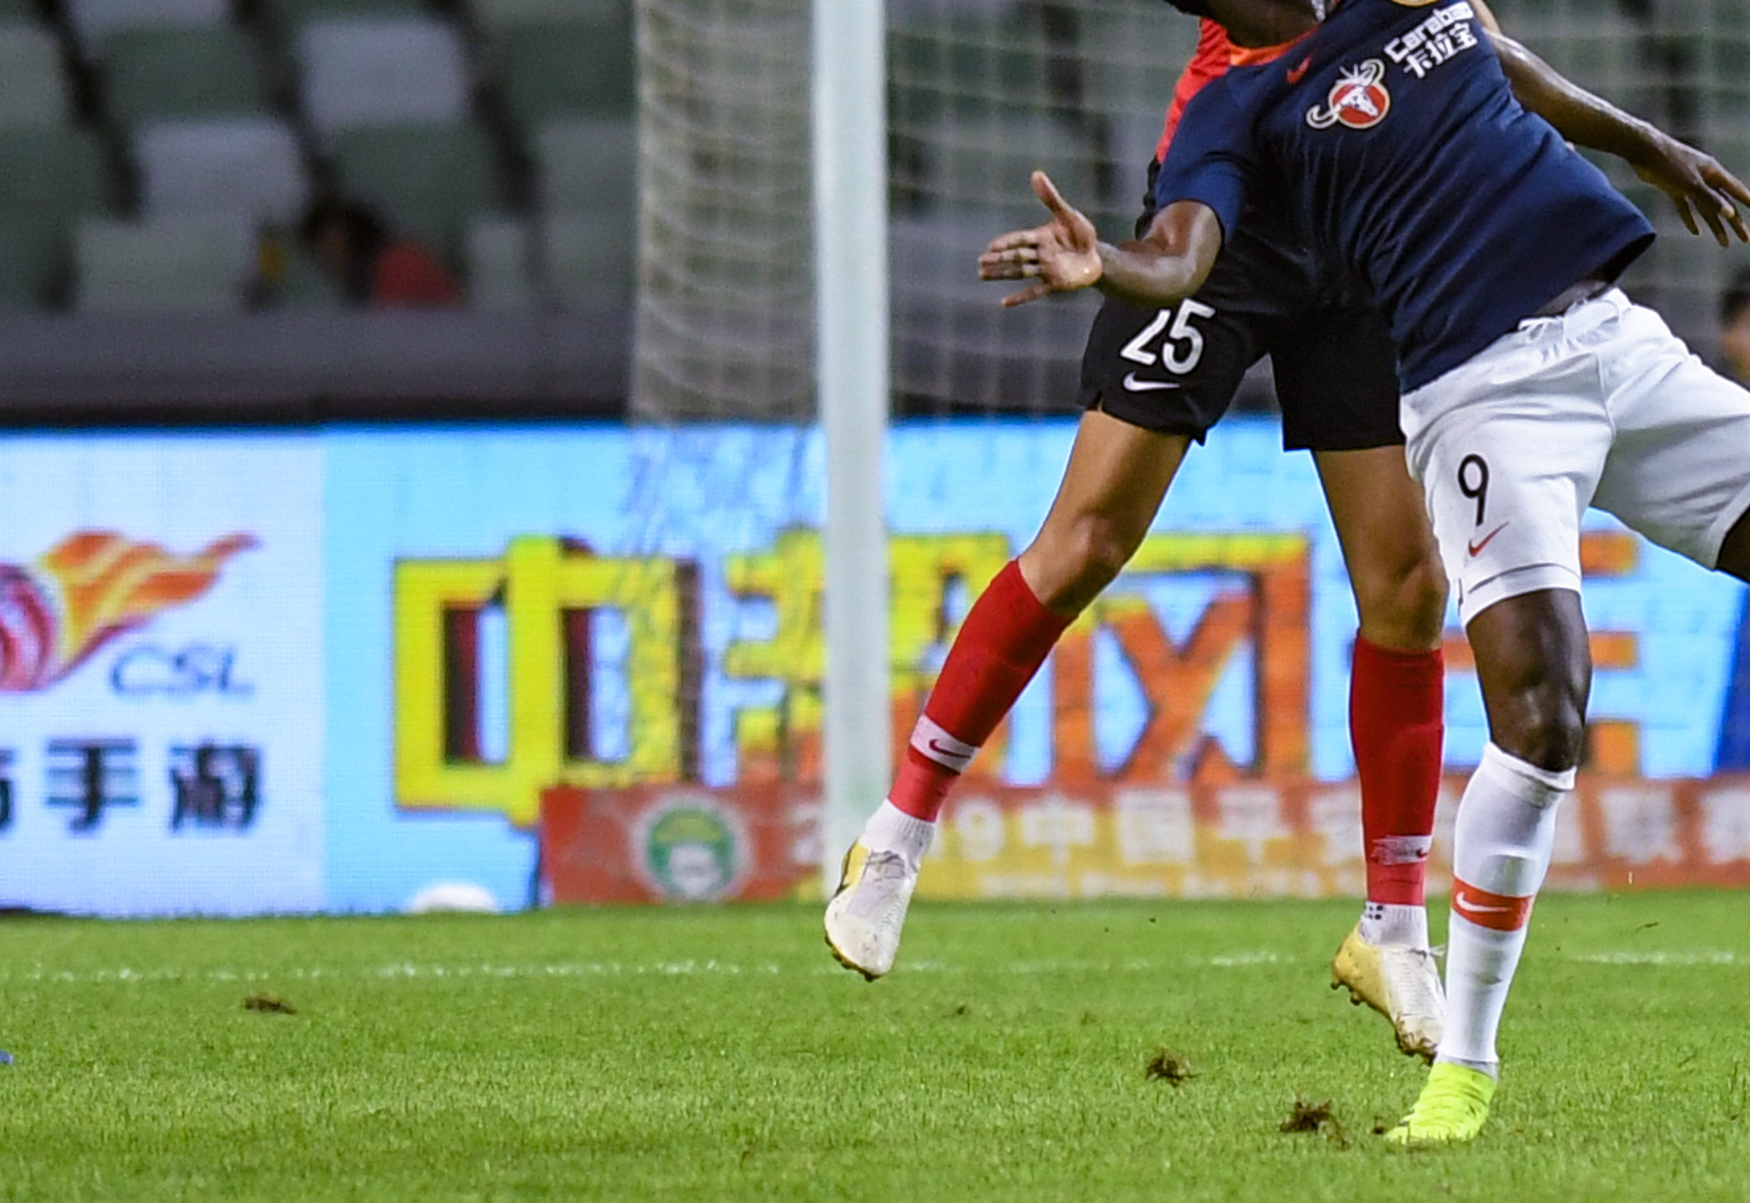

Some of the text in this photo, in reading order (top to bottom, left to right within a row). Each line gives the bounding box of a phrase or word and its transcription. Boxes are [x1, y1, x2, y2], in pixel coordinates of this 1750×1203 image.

[1403, 22, 1478, 78] 卡拉宝
[1120, 297, 1216, 375] 25
[1457, 453, 1489, 527] 9
[111, 643, 255, 697] CSL
[0, 738, 262, 833] 手游
